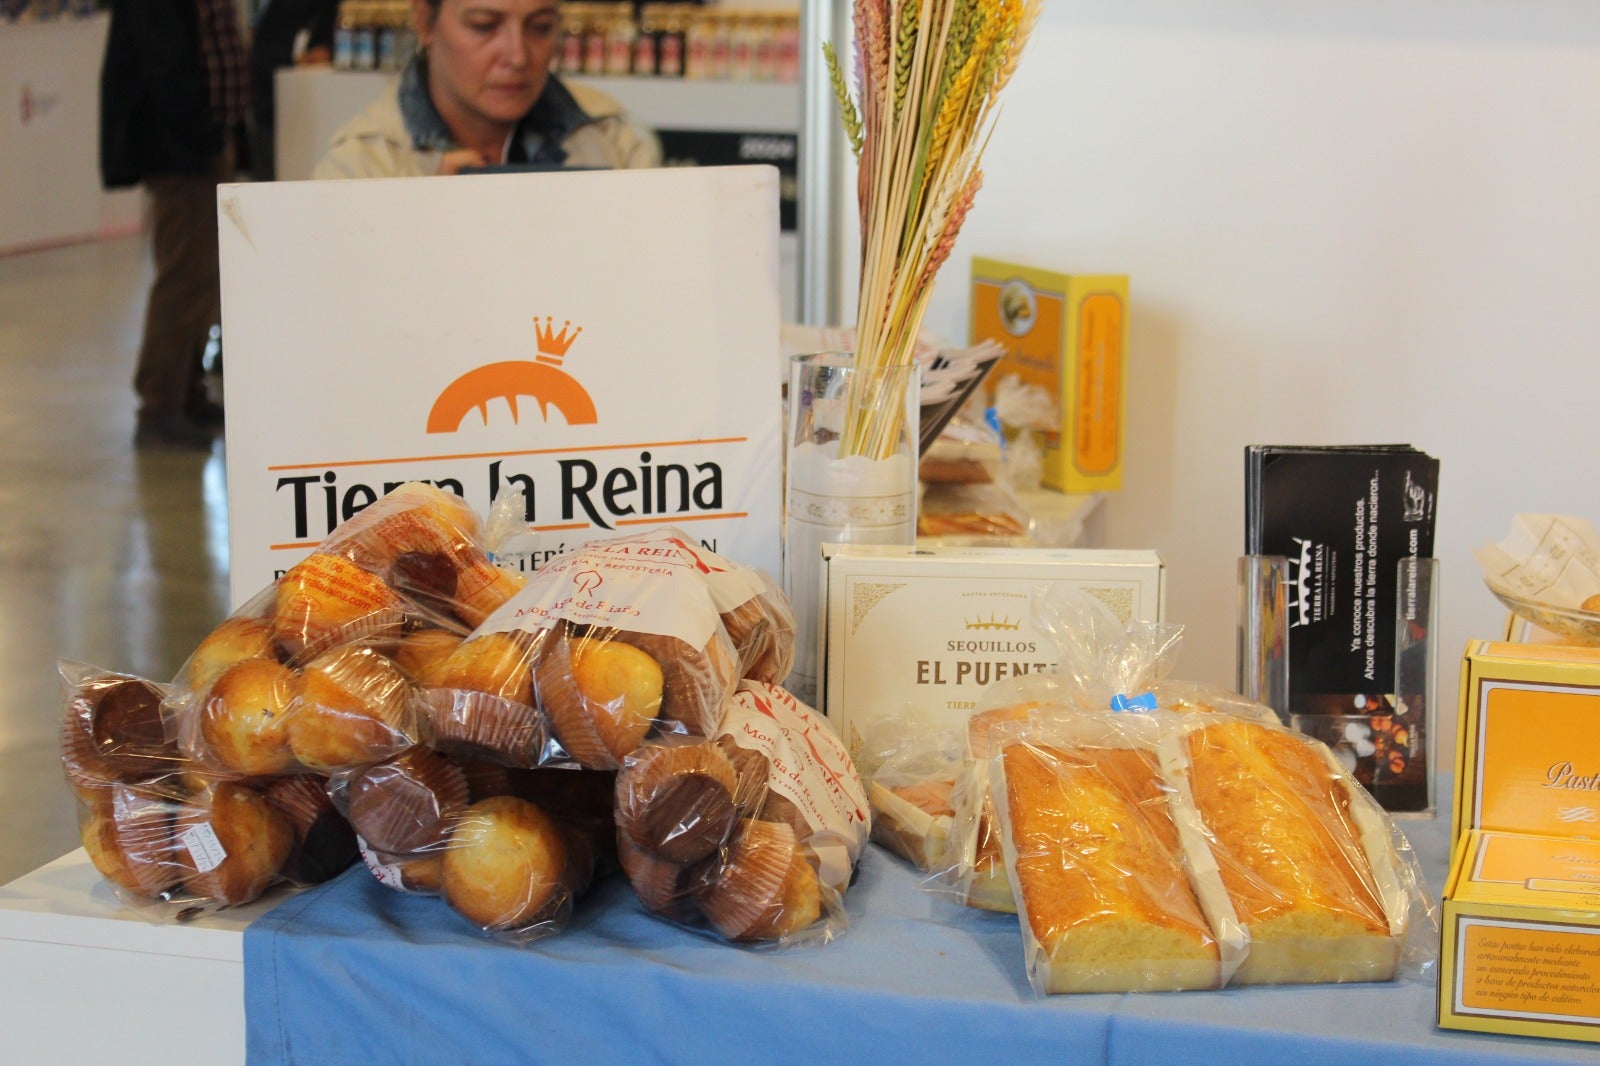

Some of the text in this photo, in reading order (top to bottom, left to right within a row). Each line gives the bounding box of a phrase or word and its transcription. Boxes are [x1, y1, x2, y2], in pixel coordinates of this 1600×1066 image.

[557, 451, 723, 530] Reina
[604, 546, 686, 560] LA REIN
[604, 562, 674, 577] REPOSTERÍA
[1351, 497, 1367, 652] Ya conoce nuestros productos.
[1364, 469, 1380, 681] Ahora descubra la tierra donde nacieron...
[1405, 528, 1418, 621] tierralareina.com
[1313, 543, 1324, 623] TIERRA LA REINA
[575, 600, 593, 610] de
[946, 639, 1037, 653] SEQUILLOS
[916, 660, 1058, 686] EL PUENT
[788, 772, 803, 786] de
[1541, 761, 1600, 792] Past
[1500, 940, 1527, 953] pastas
[1528, 941, 1544, 952] han
[1545, 943, 1562, 953] sido
[1563, 944, 1600, 957] elaborad
[1542, 956, 1581, 967] mediante
[1489, 964, 1530, 976] esmerado
[1529, 967, 1592, 980] procedimiento
[1483, 974, 1505, 986] base
[1505, 976, 1517, 987] de
[1515, 978, 1560, 991] productos
[1520, 991, 1537, 1004] tipo
[1538, 990, 1550, 1001] de
